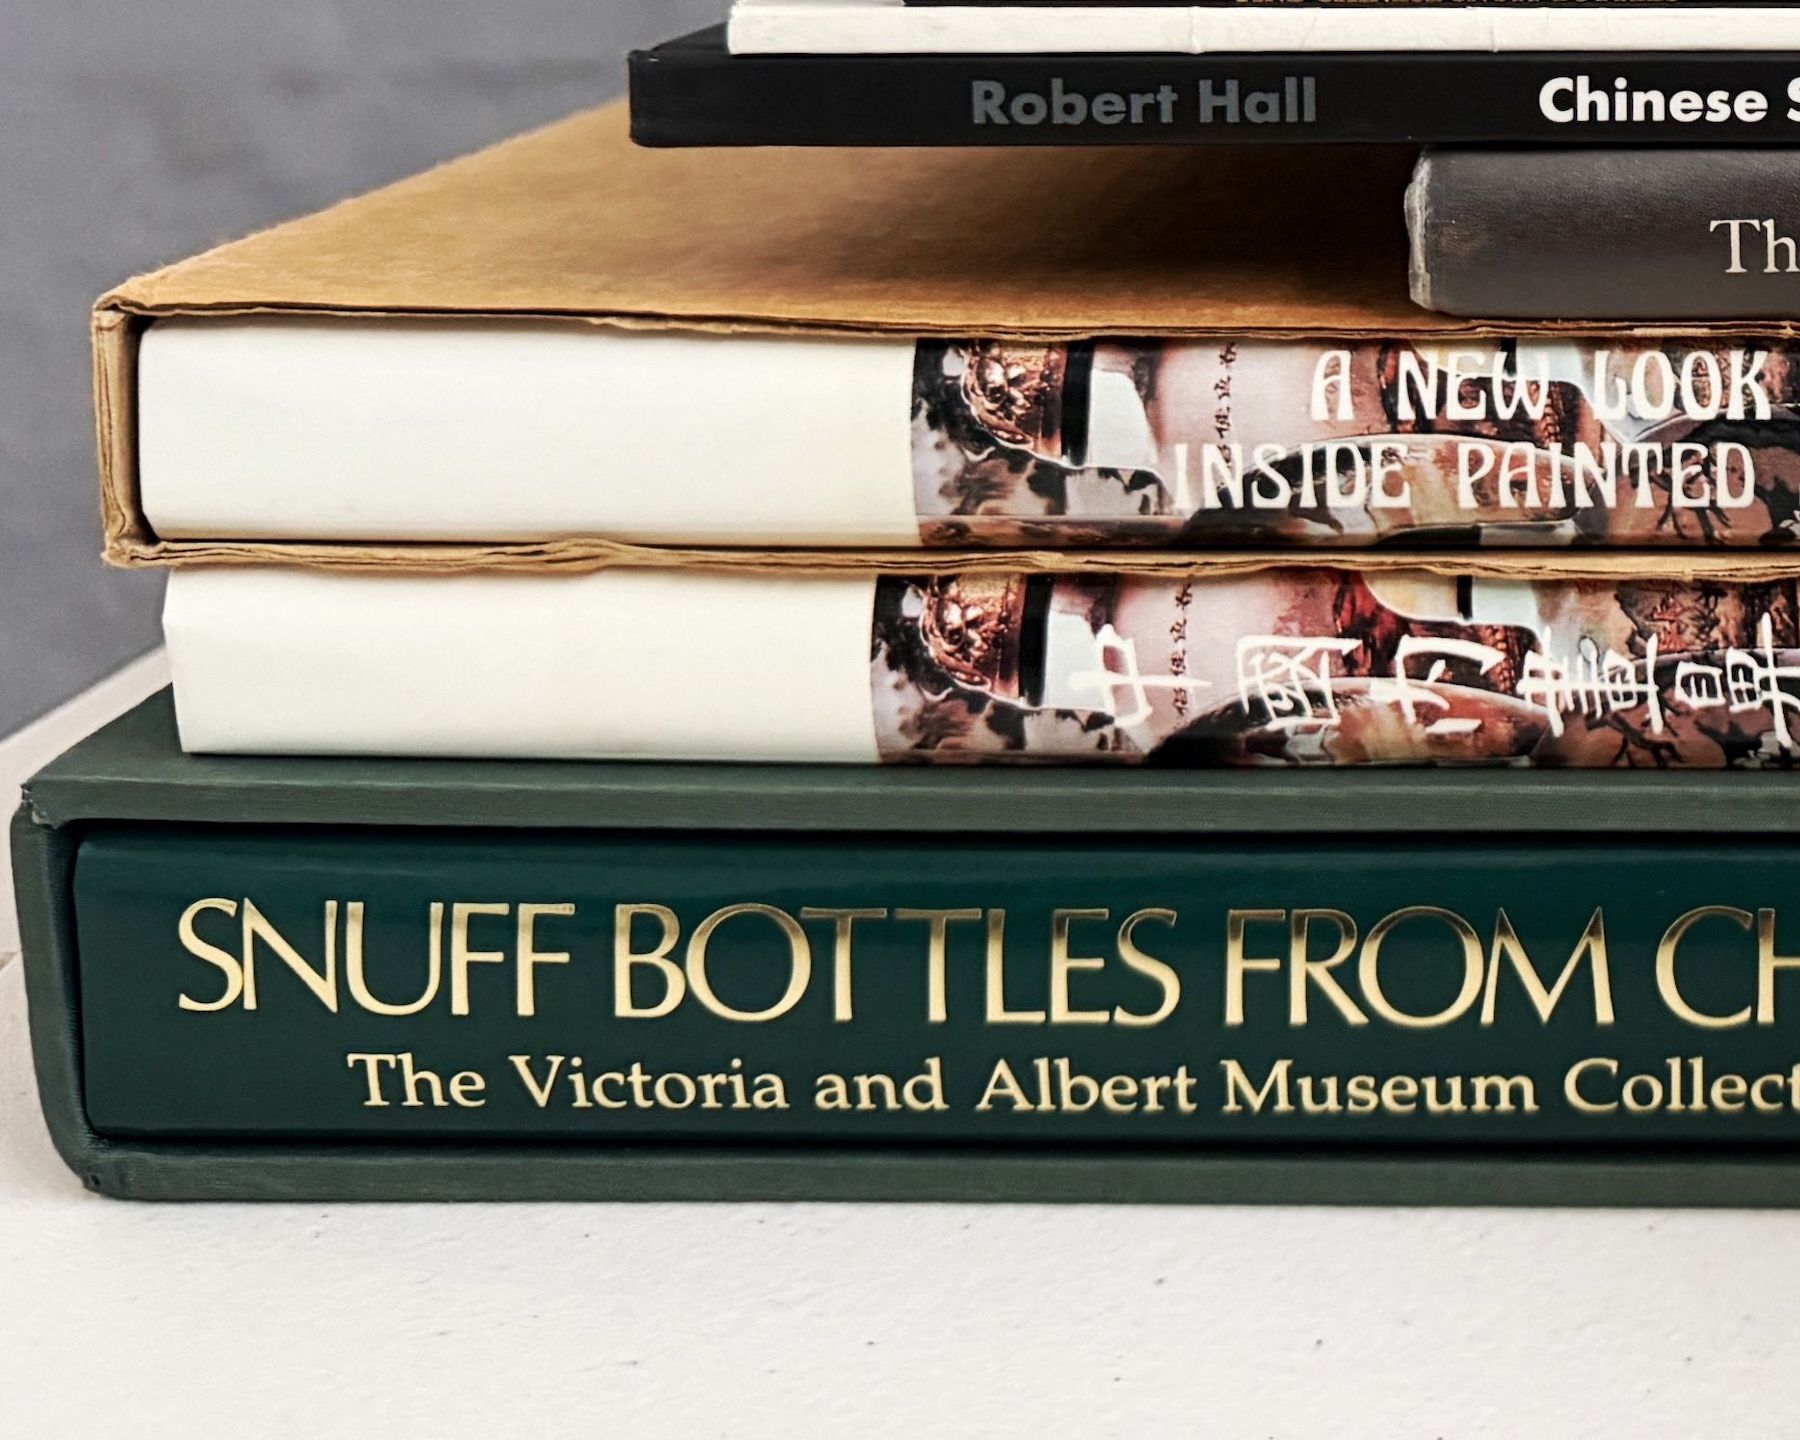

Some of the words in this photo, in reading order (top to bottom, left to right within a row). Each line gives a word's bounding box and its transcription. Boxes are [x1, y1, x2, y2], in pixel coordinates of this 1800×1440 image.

[971, 76, 1180, 126] Robert
[1197, 75, 1318, 126] Hall
[1537, 74, 1769, 124] Chinese
[1310, 349, 1354, 421] A
[1395, 349, 1551, 420] NEW
[1591, 349, 1773, 421] LOOK
[1173, 440, 1412, 511] INSIDE
[1456, 441, 1757, 511] PAINTED
[177, 896, 577, 1017] SNUFF
[610, 903, 1181, 1027] BOTTLES
[1225, 906, 1616, 1029] FROM
[346, 1052, 487, 1109] The
[508, 1055, 791, 1110] Victoria
[814, 1056, 951, 1112] and
[975, 1057, 1198, 1113] Albert
[1220, 1059, 1540, 1114] Museum
